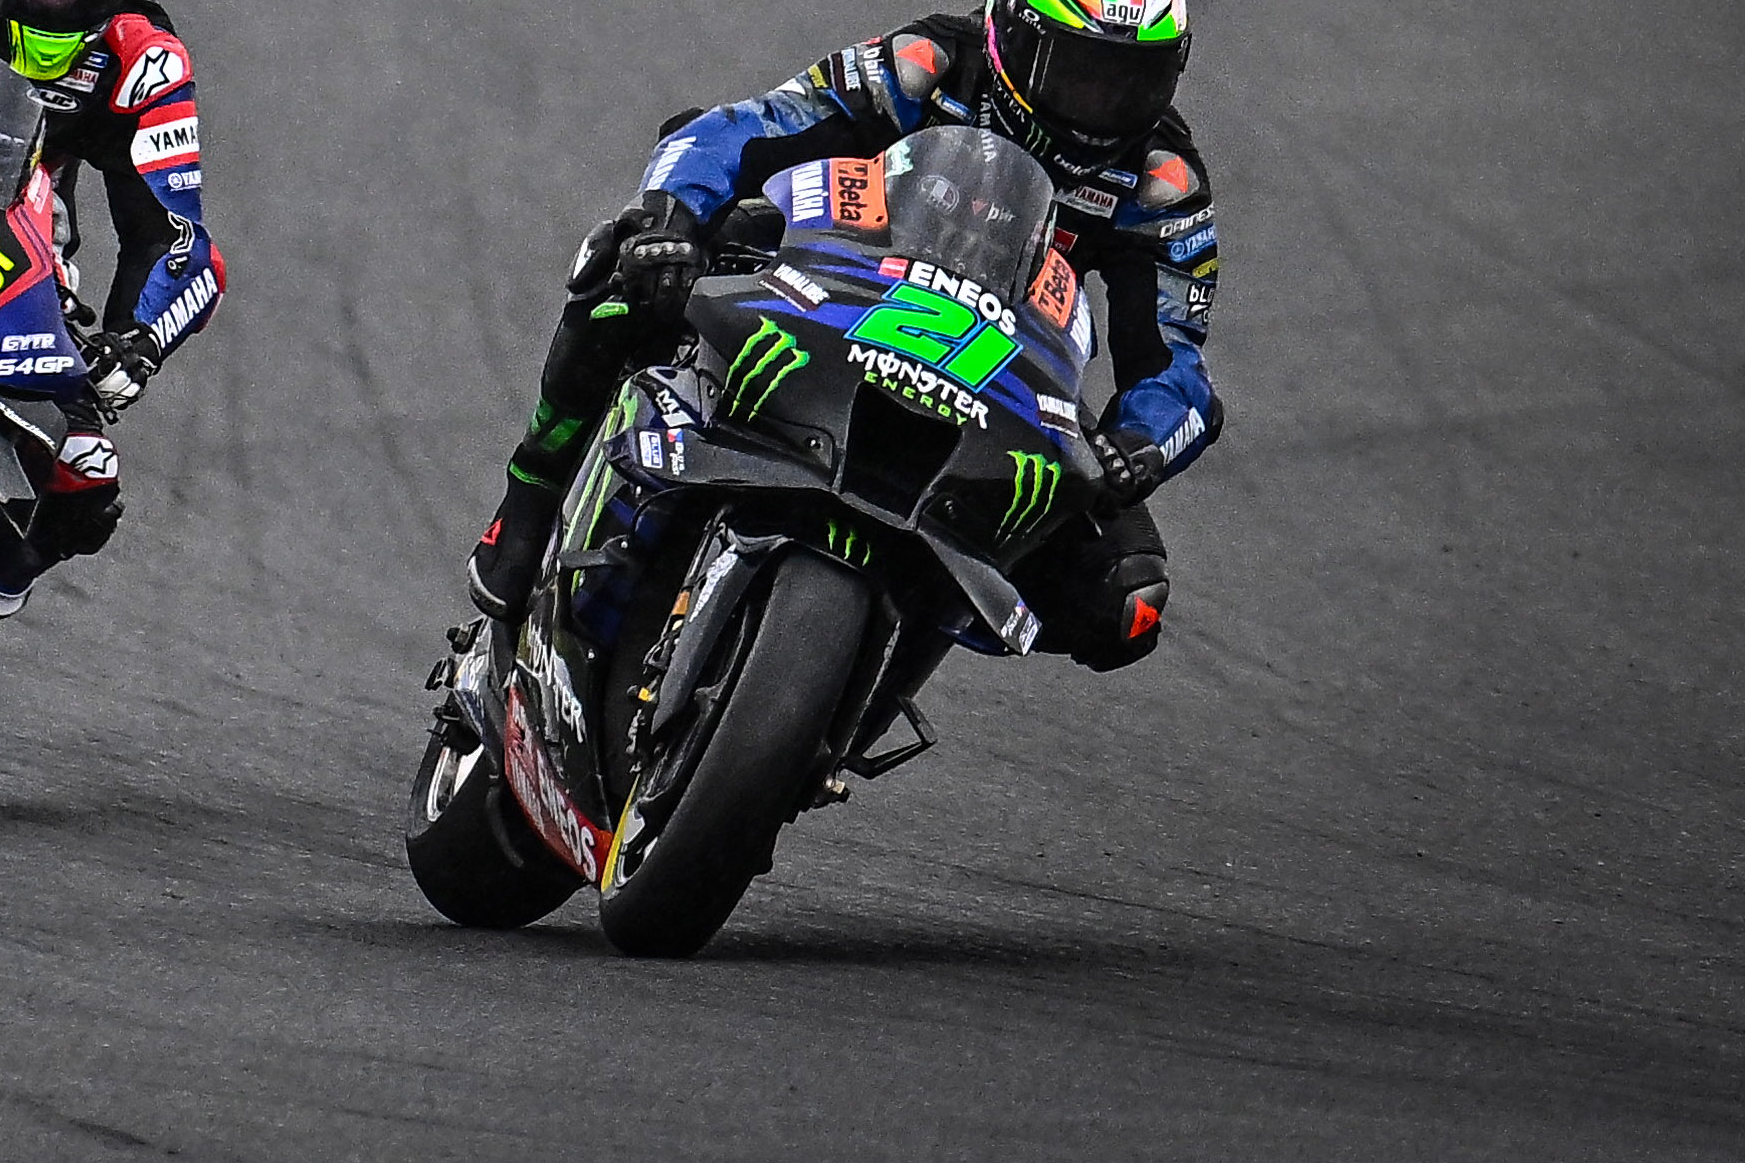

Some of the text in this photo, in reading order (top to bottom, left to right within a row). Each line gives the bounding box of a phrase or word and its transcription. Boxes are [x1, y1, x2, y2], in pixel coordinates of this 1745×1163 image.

[1106, 3, 1141, 23] agv
[149, 125, 198, 153] YAMA
[980, 93, 996, 163] AMAHA
[1159, 201, 1216, 238] DAINES
[1184, 224, 1217, 254] YAMAH
[151, 267, 218, 348] YAMAHA
[908, 261, 1016, 336] ENEOS
[1, 333, 56, 352] GYTR
[844, 280, 1023, 393] 21
[847, 344, 989, 429] MONSTER
[864, 371, 967, 425] ENERGY
